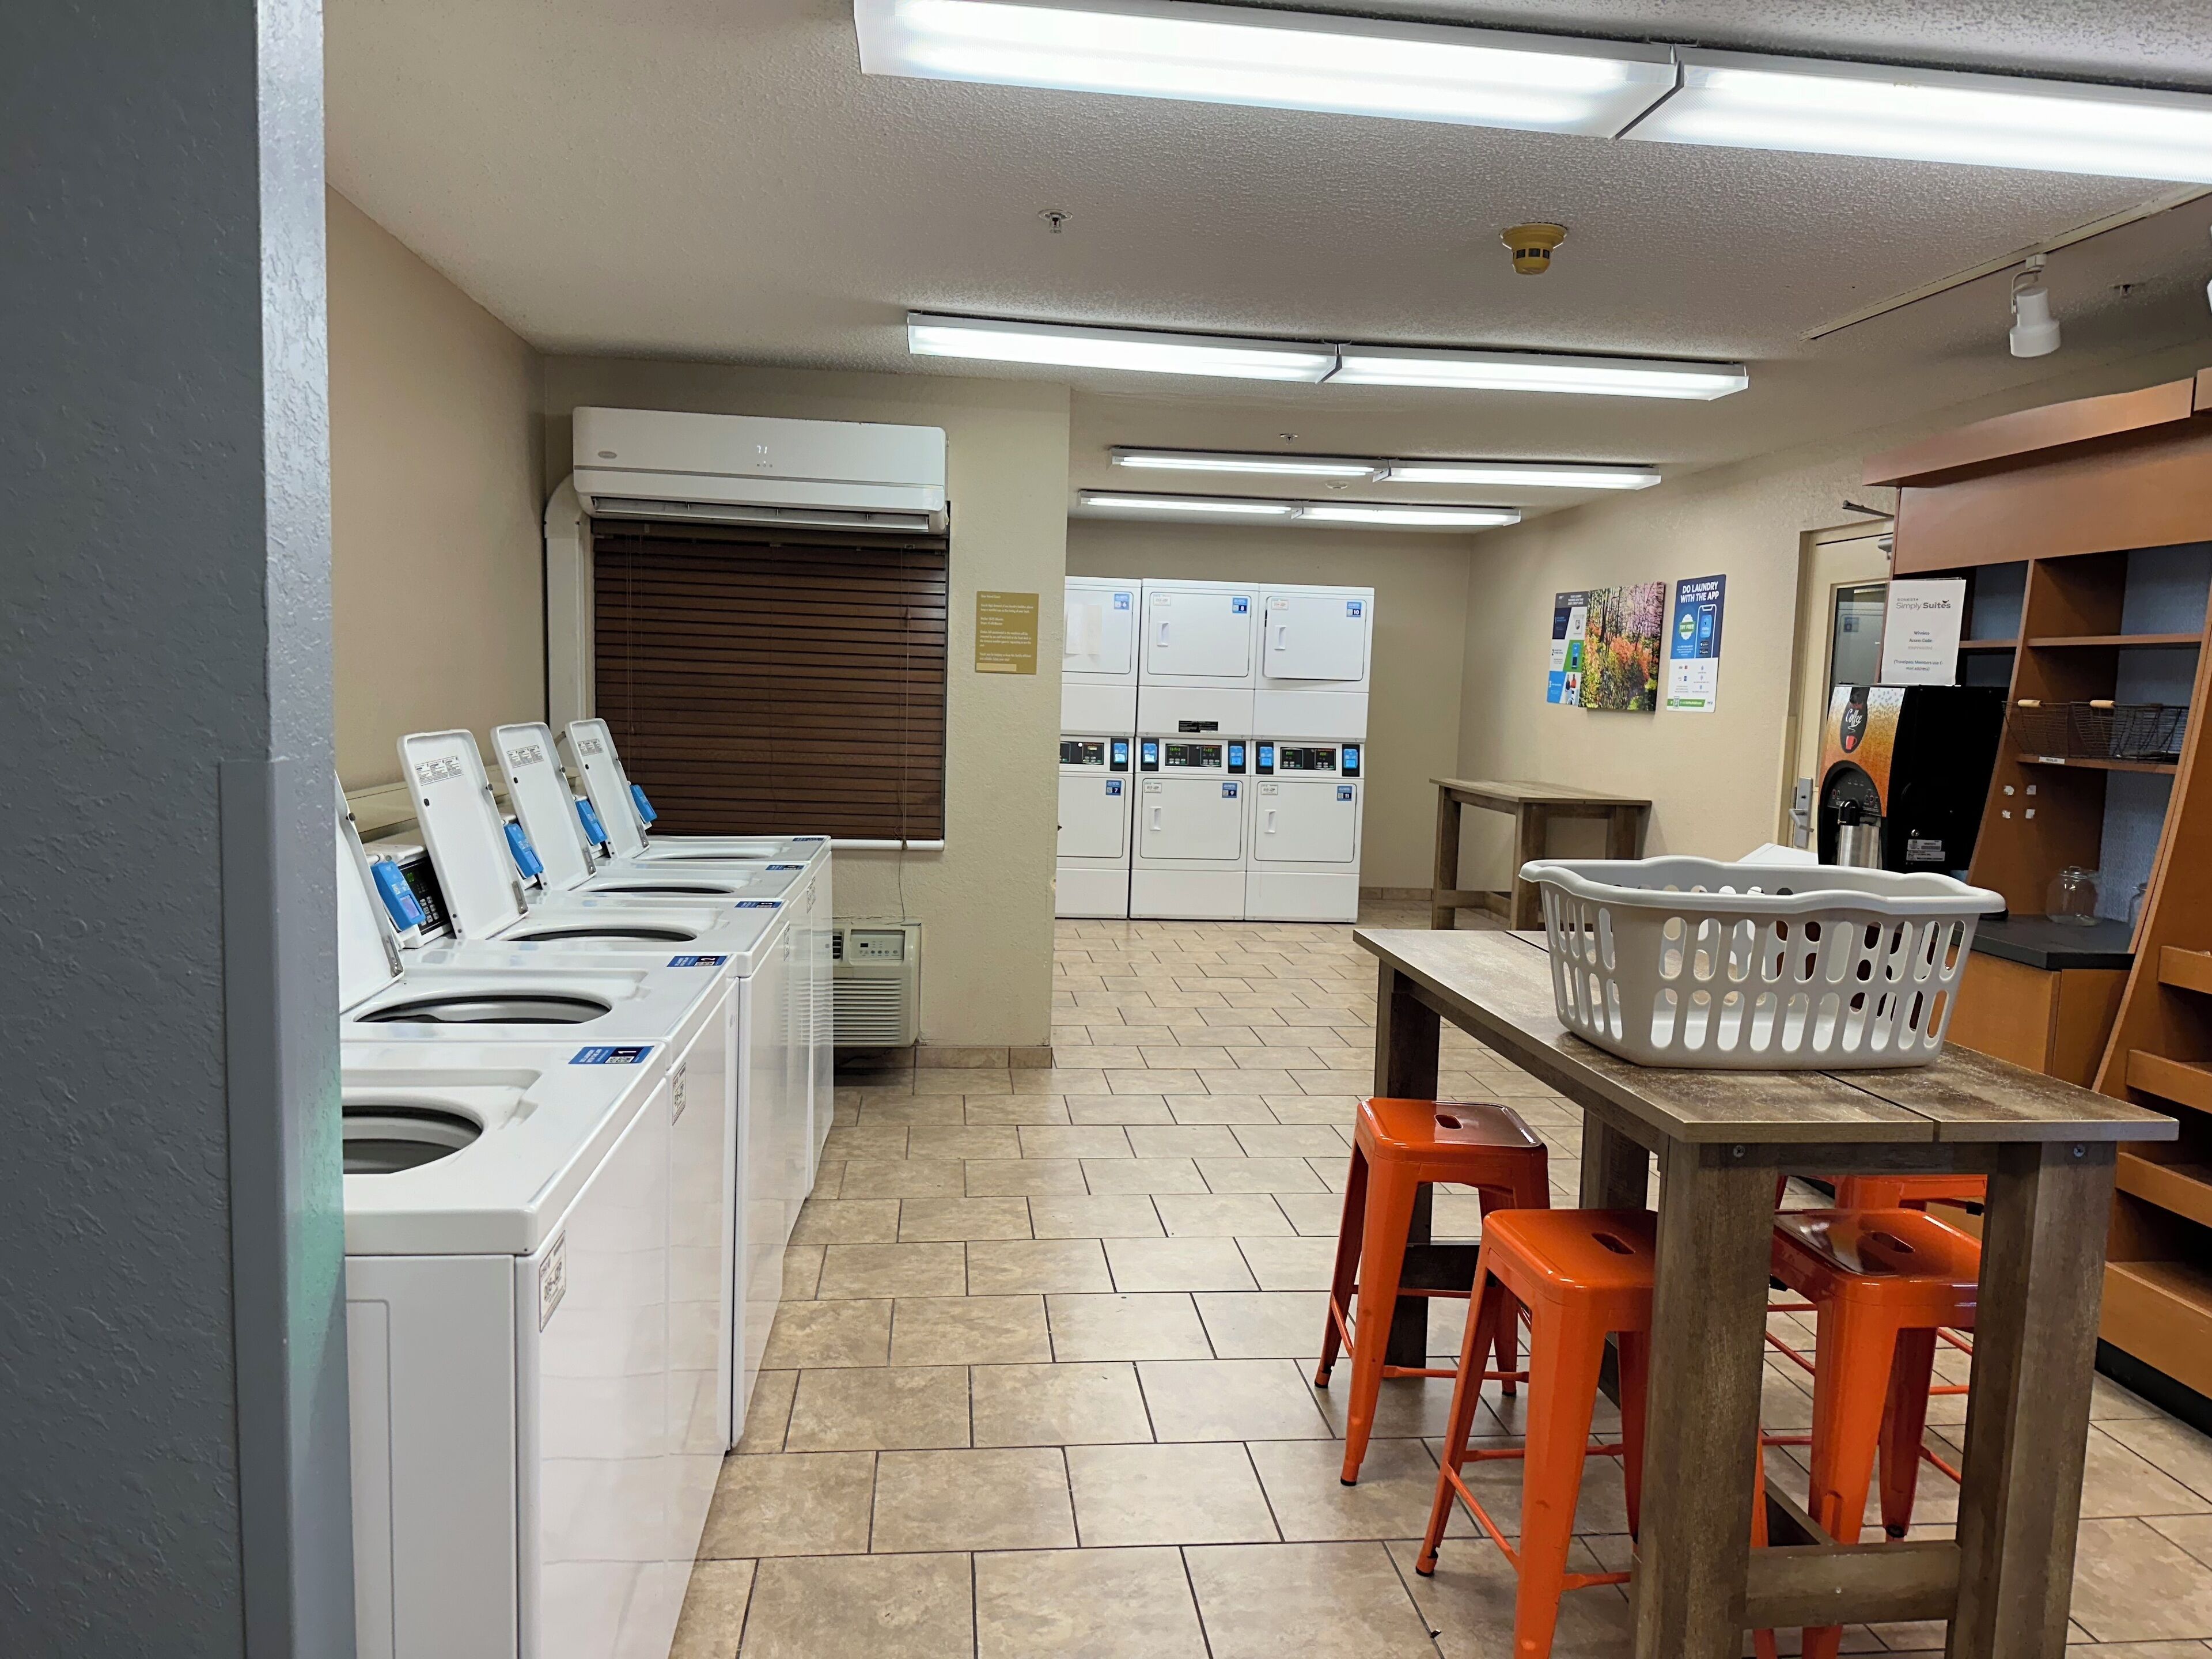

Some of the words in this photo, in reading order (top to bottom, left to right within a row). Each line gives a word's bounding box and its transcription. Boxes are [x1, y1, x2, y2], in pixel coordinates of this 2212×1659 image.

[756, 445, 767, 454] 71
[1682, 584, 1691, 593] DO
[1691, 581, 1718, 593] LAUNDRY
[1680, 594, 1695, 603] WITH
[1696, 592, 1707, 601] THE
[1707, 590, 1719, 600] APP
[1896, 602, 1921, 610] Simply
[1845, 709, 1862, 726] Coffee
